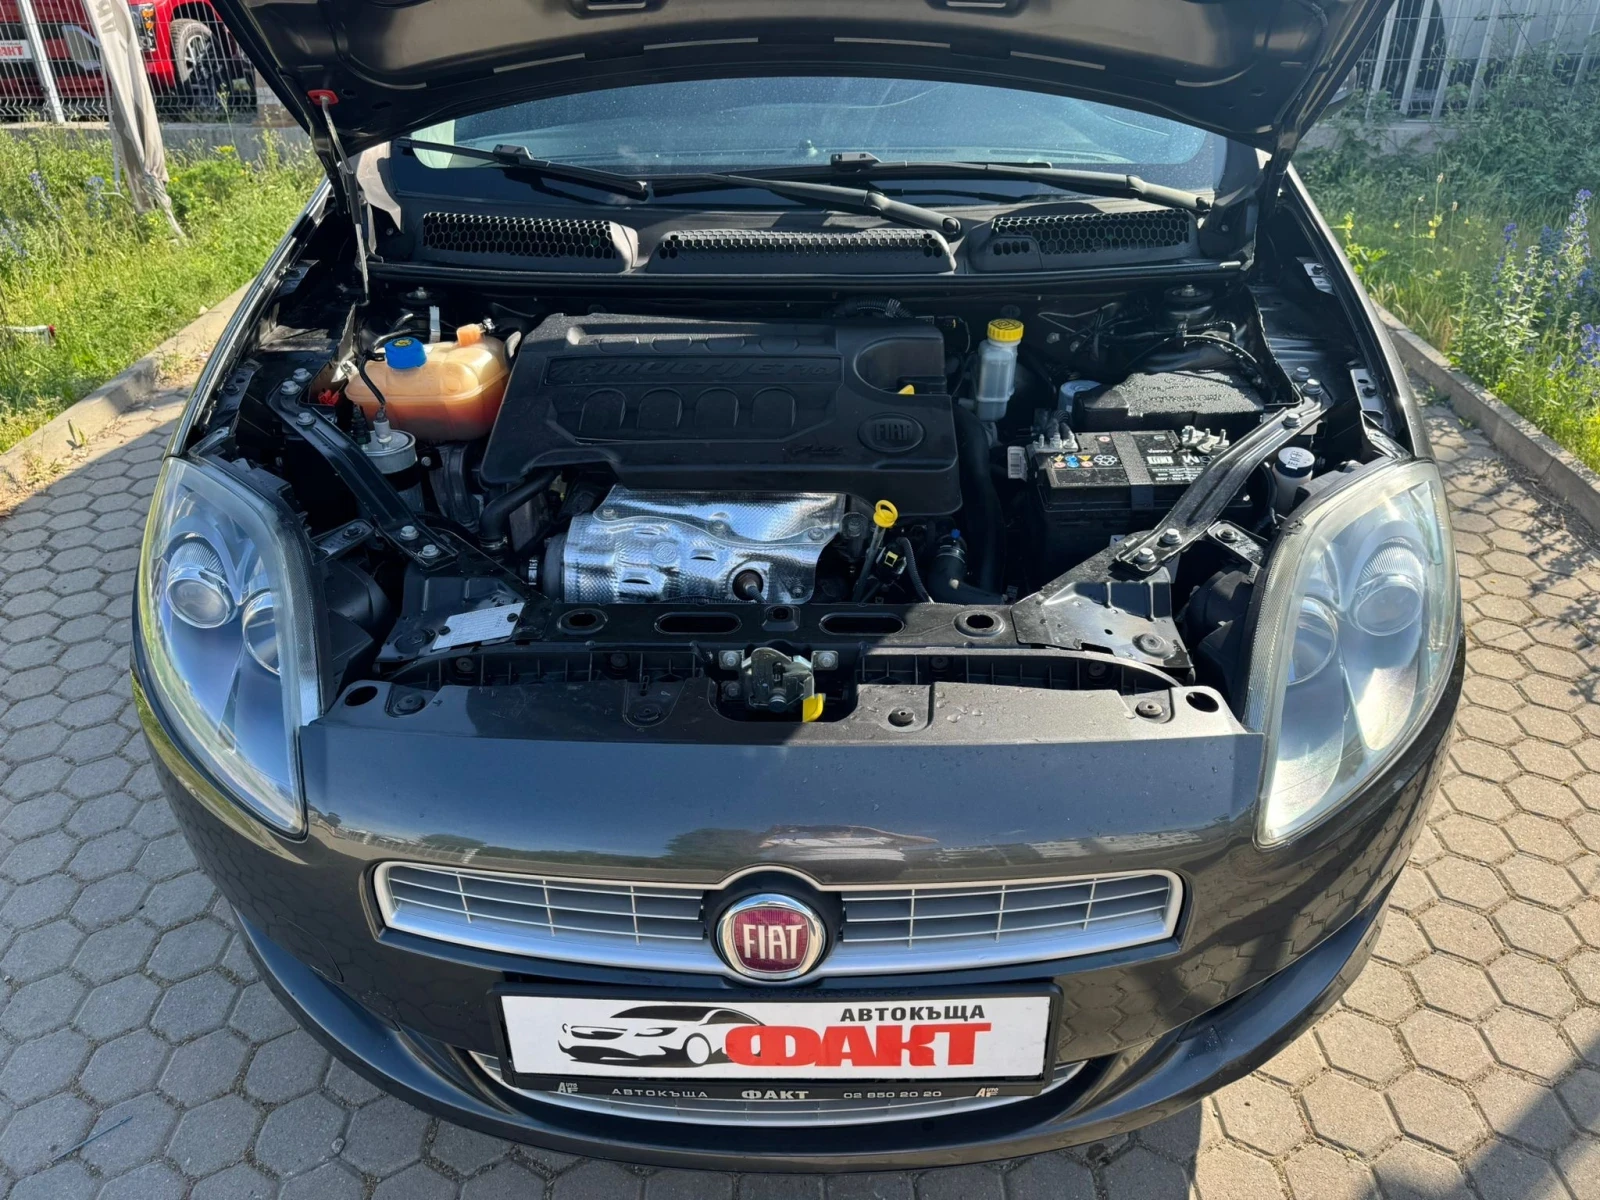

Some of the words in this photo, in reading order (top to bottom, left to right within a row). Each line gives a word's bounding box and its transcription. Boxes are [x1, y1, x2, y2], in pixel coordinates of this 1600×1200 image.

[874, 422, 915, 442] FIAT
[742, 923, 803, 960] FIAT
[840, 1004, 986, 1022] АВТОКЪЩА
[725, 1022, 992, 1067] ФАКТ
[741, 1089, 810, 1100] ФАКТ
[843, 1092, 863, 1100] 02
[867, 1091, 896, 1099] 850
[900, 1091, 919, 1099] 20
[923, 1090, 943, 1098] 20
